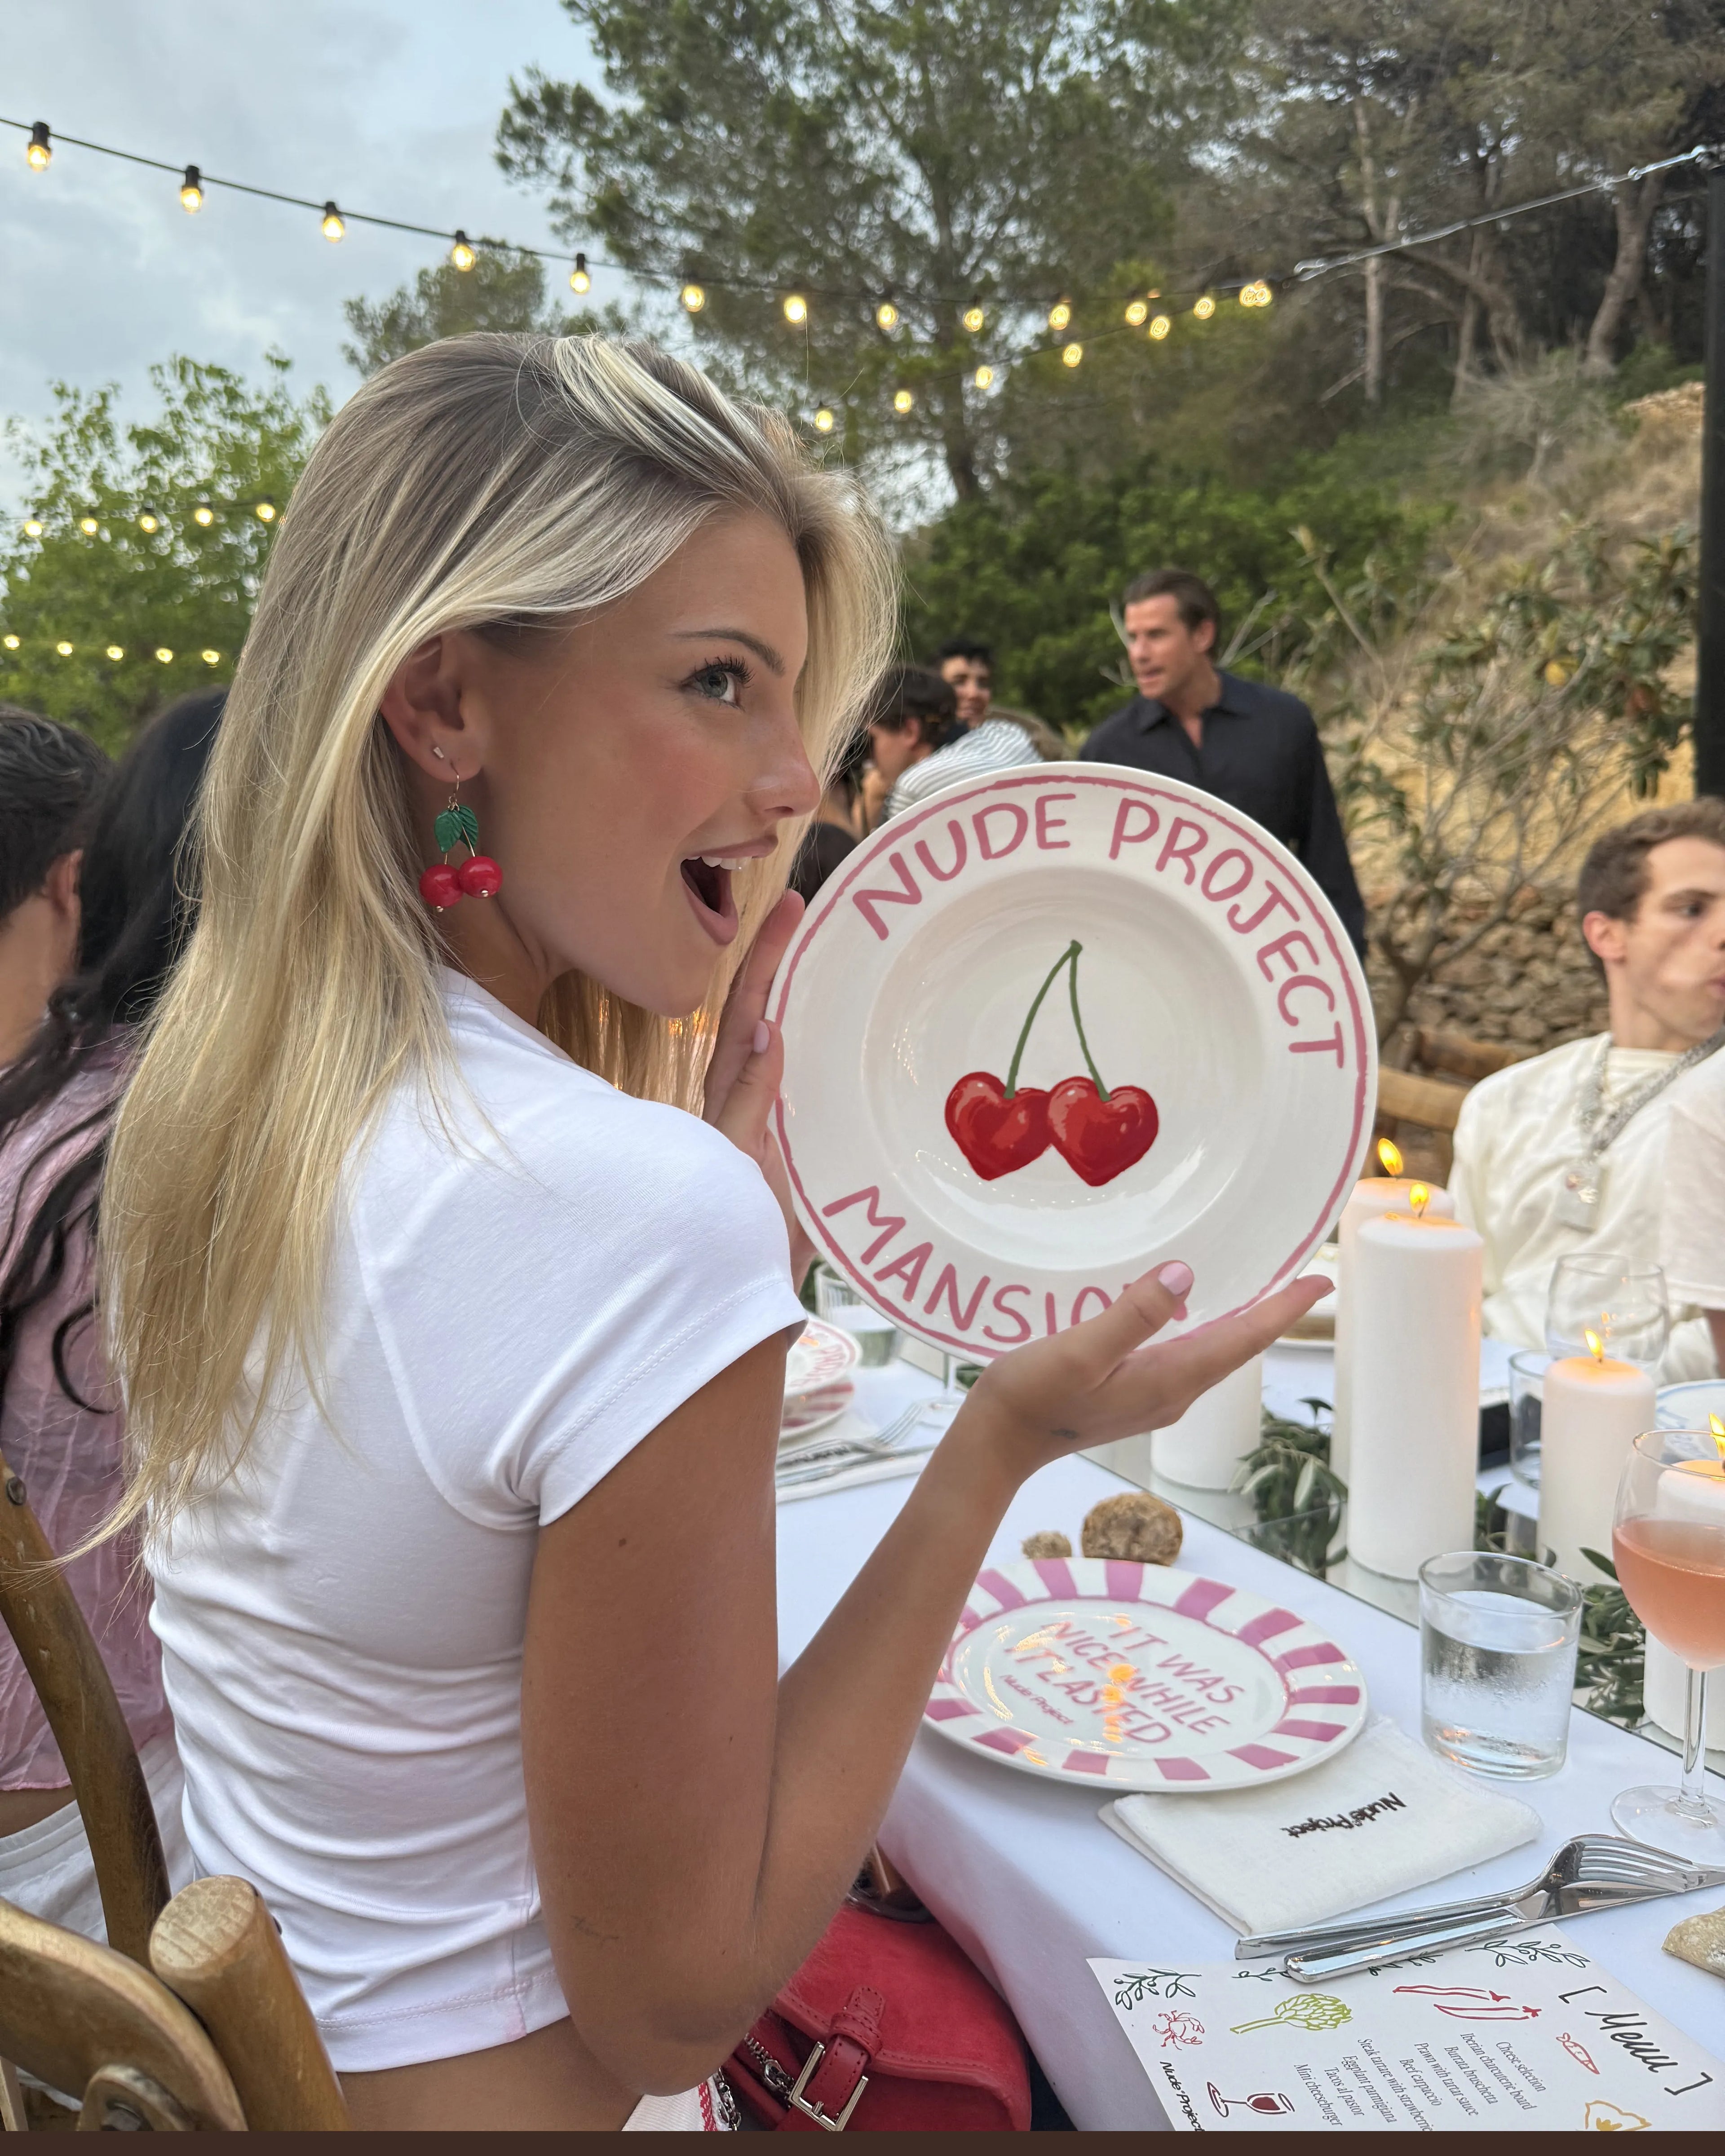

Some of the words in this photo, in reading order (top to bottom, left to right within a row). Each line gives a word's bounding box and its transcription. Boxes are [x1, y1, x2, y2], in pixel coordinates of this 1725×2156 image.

[852, 793, 1076, 940] NUDE
[1109, 798, 1344, 1068] PROJECT
[822, 1185, 1187, 1343] MANSIO
[1040, 1621, 1128, 1670] NICE
[1108, 1626, 1169, 1650] IT
[1156, 1653, 1245, 1703] WAS
[999, 1674, 1032, 1696] Nude
[1030, 1697, 1074, 1724] Project
[1036, 1666, 1172, 1743] LASTED
[1280, 1813, 1354, 1838] Project
[1349, 1791, 1407, 1821] Nude
[1358, 2038, 1380, 2056] Steak
[1370, 2055, 1393, 2078] tartare
[1387, 2076, 1407, 2093] with
[1496, 2041, 1521, 2063] Cheese
[1514, 2062, 1546, 2092] selection
[1584, 2011, 1678, 2073] Menu
[1159, 2061, 1182, 2090] Nude
[1176, 2093, 1205, 2131] Project
[1294, 2063, 1316, 2081] Mini
[1305, 2080, 1343, 2126] cheeseburger
[1324, 2067, 1344, 2088] Tacos
[1336, 2086, 1354, 2095] al
[1341, 2055, 1371, 2088] Eggplant
[1362, 2084, 1398, 2123] parmigiana
[1399, 2059, 1422, 2073] Beef
[1411, 2071, 1442, 2106] carpaccio
[1414, 2043, 1437, 2063] Prawn
[1432, 2063, 1451, 2078] with
[1442, 2076, 1463, 2096] tartar
[1457, 2094, 1478, 2116] sauce
[1444, 2046, 1470, 2071] Burrata
[1464, 2069, 1498, 2104] bruschetta
[1460, 2033, 1486, 2056] Iberian
[1480, 2055, 1517, 2090] charcuterie
[1510, 2089, 1537, 2110] board
[1337, 2094, 1365, 2116] pastor
